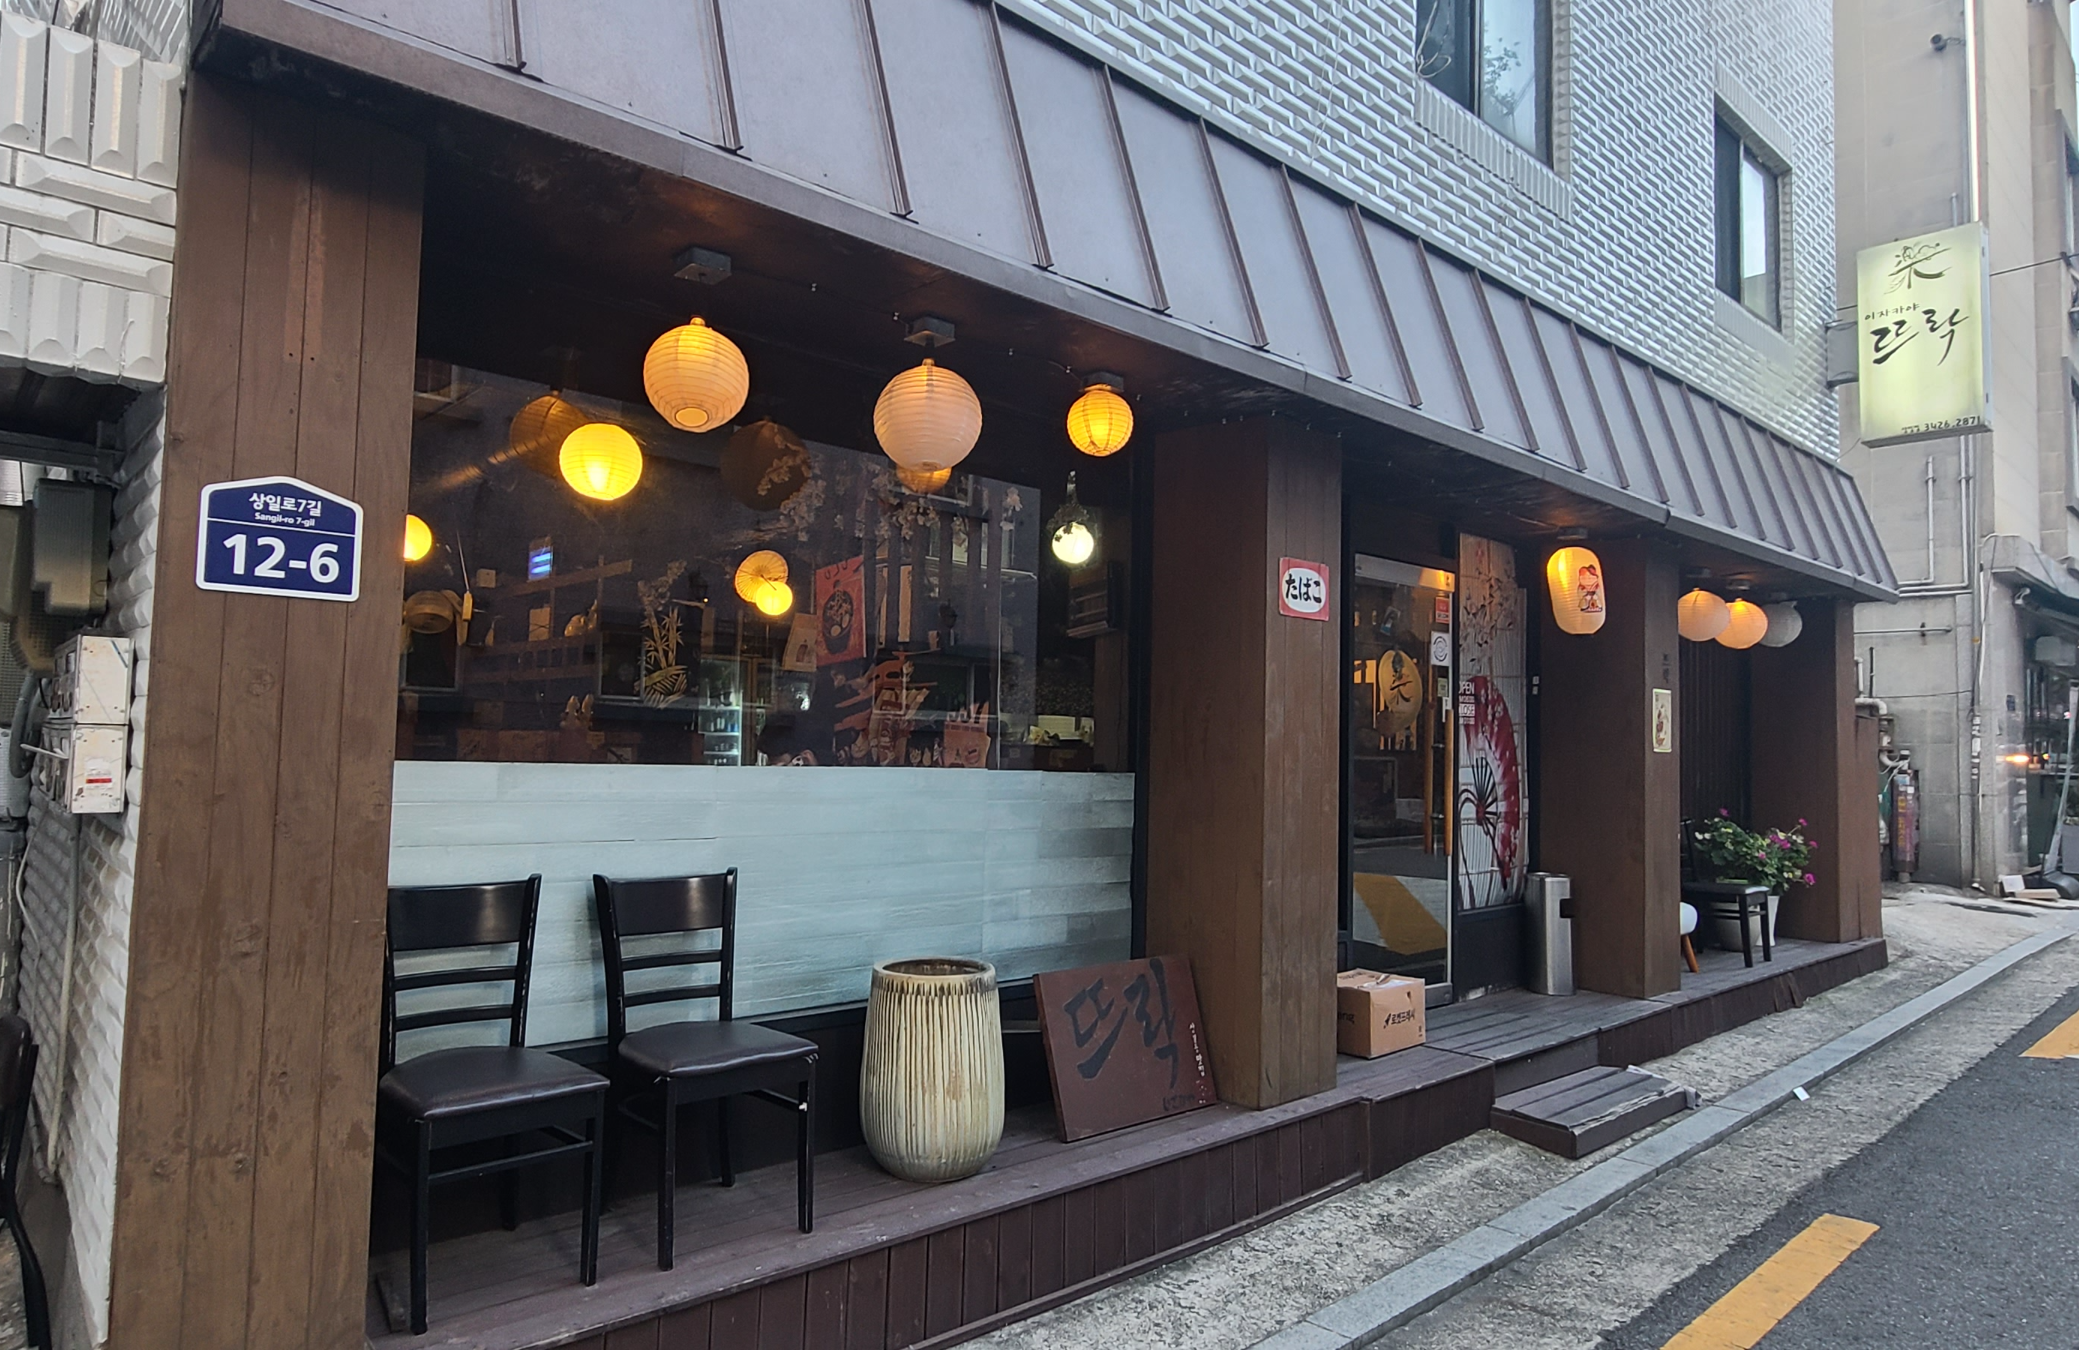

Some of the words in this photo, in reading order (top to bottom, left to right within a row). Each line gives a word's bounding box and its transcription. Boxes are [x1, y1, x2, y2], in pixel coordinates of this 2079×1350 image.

[1864, 302, 1921, 321] 이자카야
[248, 492, 322, 517] 상일로7길
[254, 511, 295, 524] Sangil-ro
[295, 516, 316, 527] 7-gil
[223, 532, 340, 584] 12-6
[1284, 572, 1323, 604] たばこ
